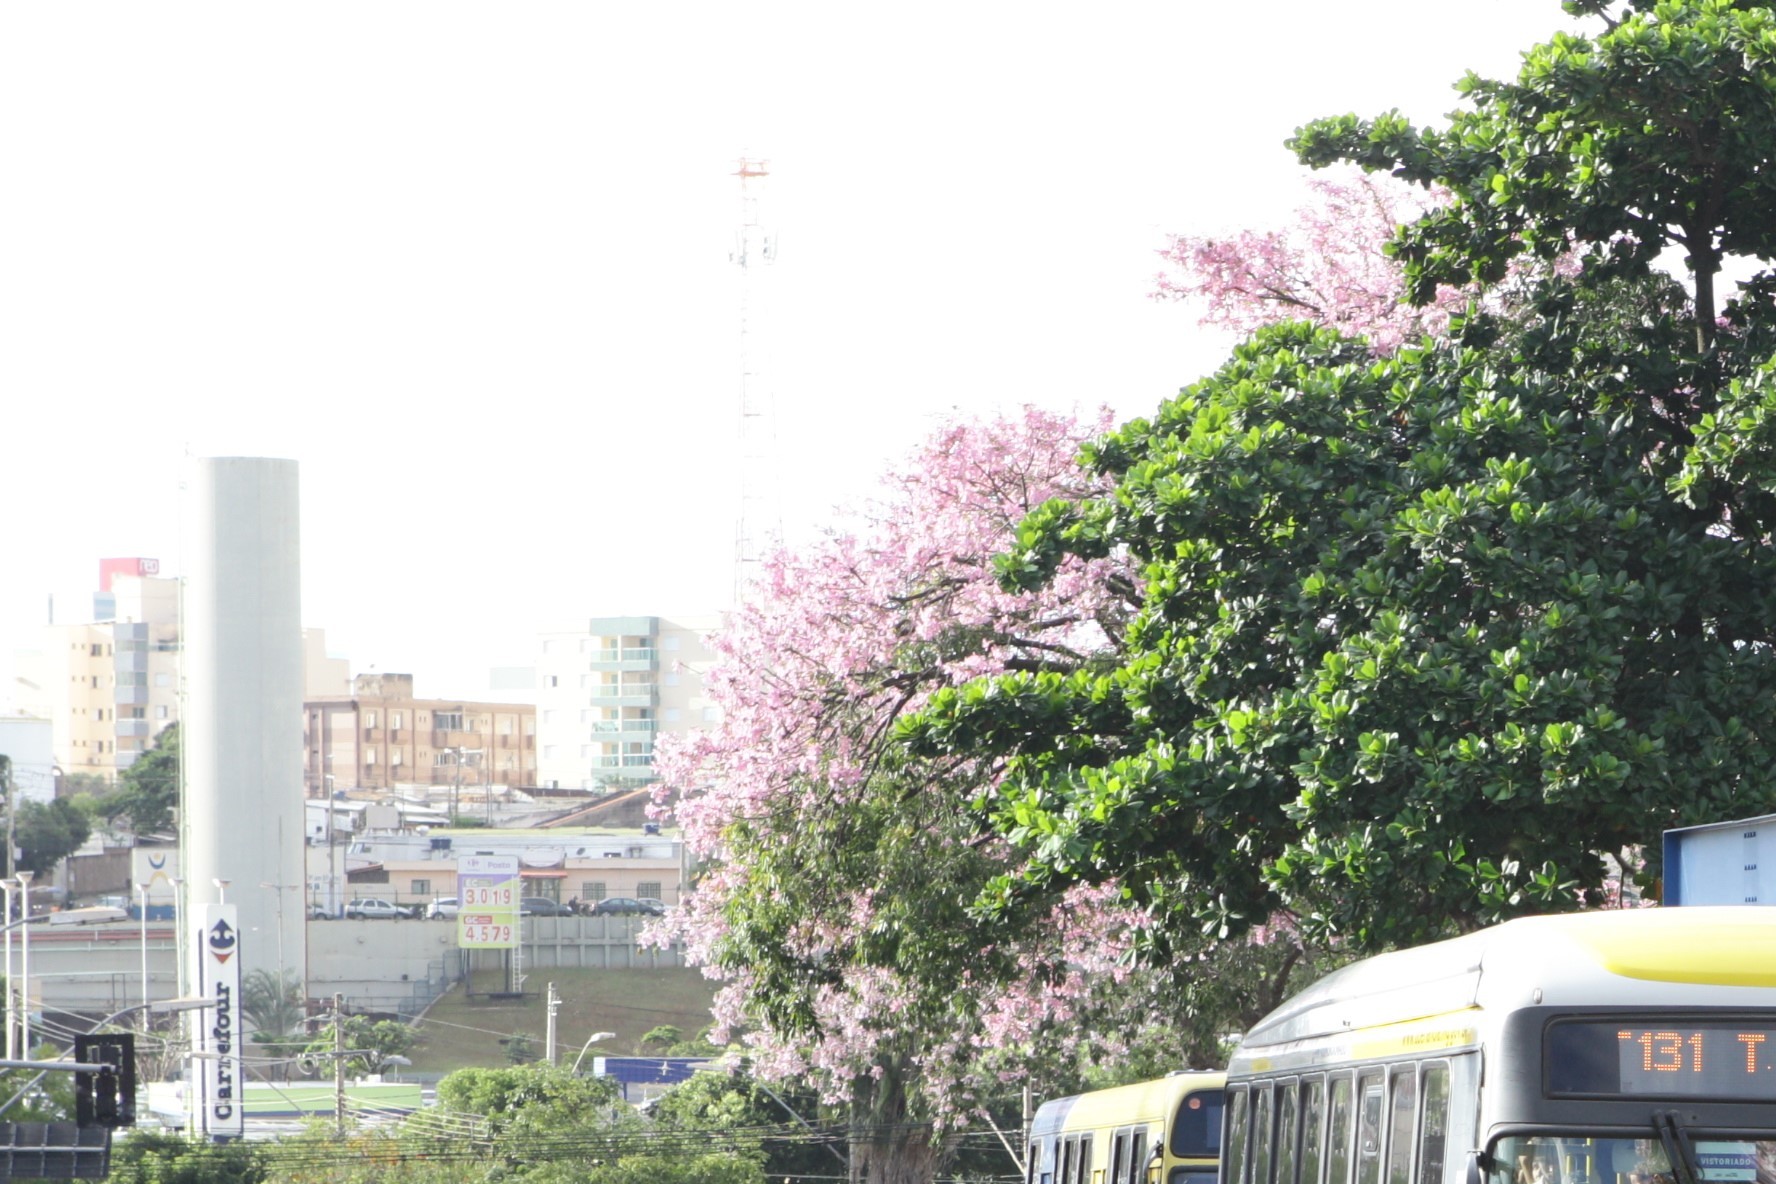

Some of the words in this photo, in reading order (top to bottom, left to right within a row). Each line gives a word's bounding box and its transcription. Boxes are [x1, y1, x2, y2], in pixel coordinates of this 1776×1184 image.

[487, 861, 511, 869] Posto
[213, 981, 233, 1120] Carrefour
[1700, 1157, 1752, 1166] VISTORIADO
